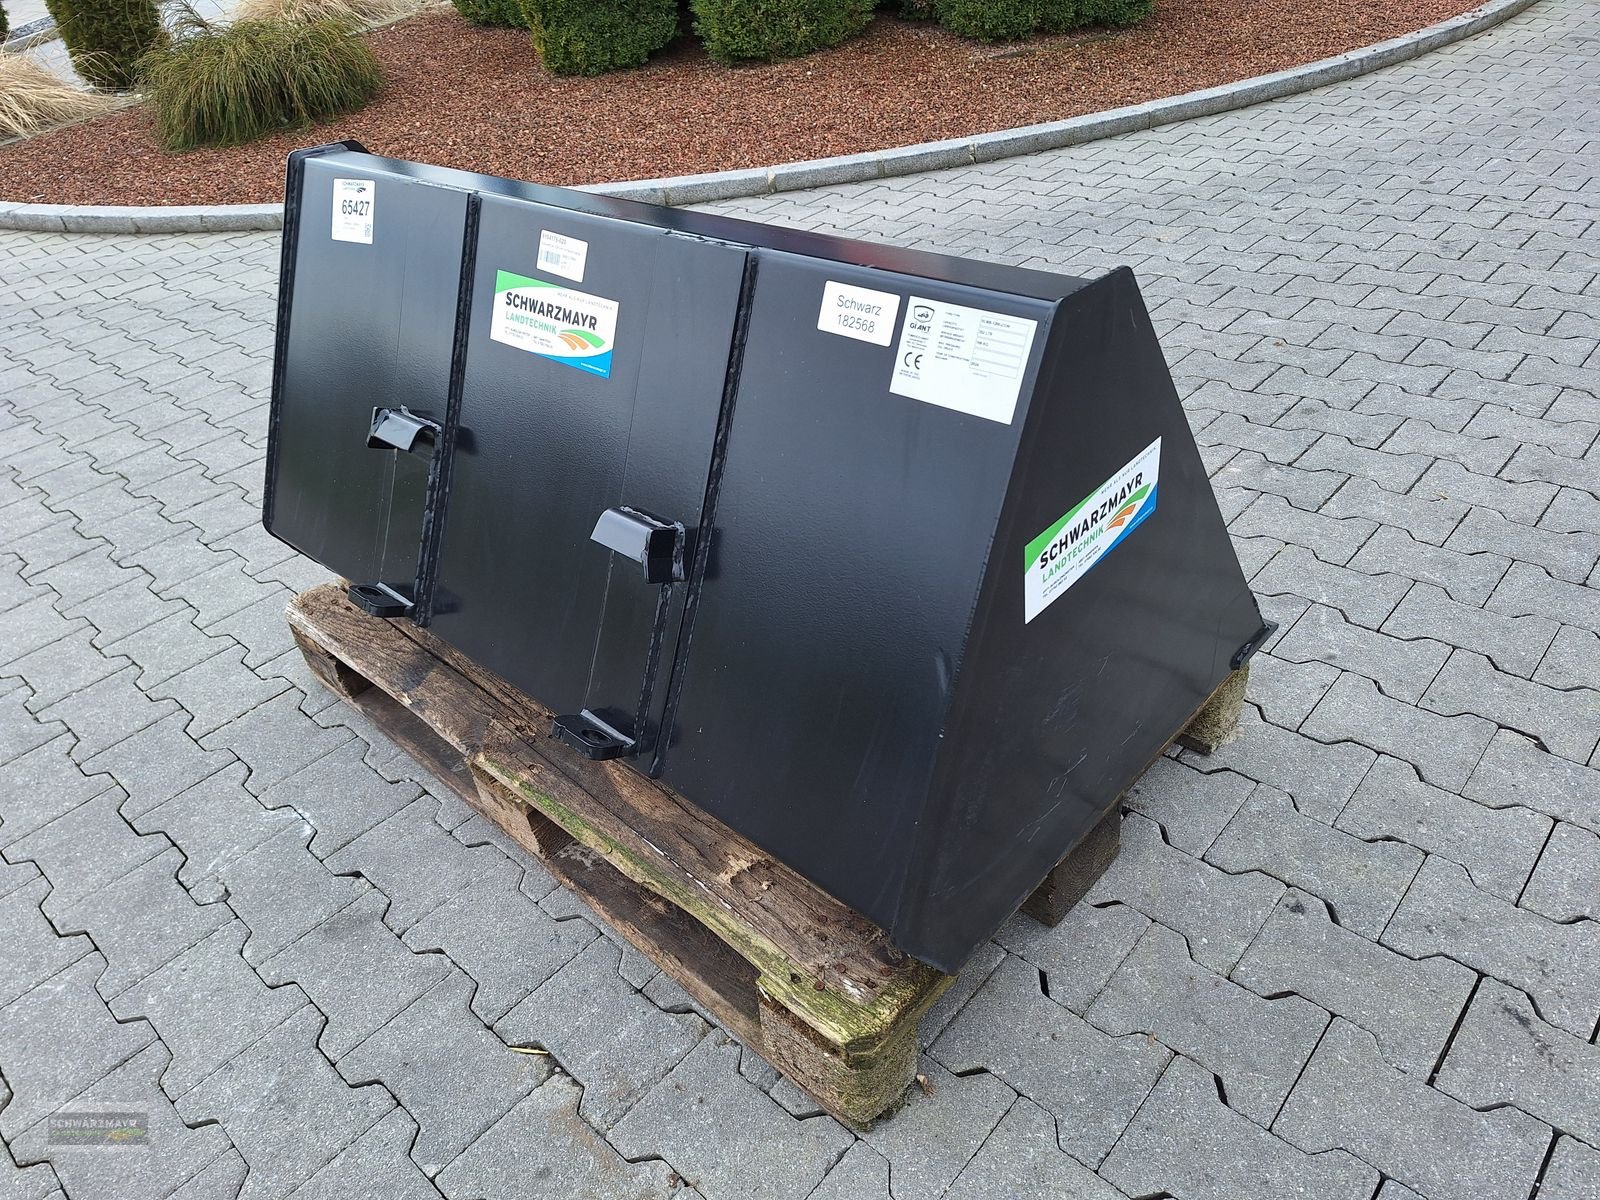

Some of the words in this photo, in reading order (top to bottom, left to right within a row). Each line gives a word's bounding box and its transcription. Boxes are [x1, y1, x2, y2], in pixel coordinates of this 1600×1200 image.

[342, 199, 370, 216] 65427
[505, 291, 598, 331] SCHWARZMAYR
[837, 294, 882, 316] Schwarz
[505, 311, 557, 335] LANDTECHNIK
[838, 314, 875, 333] 182568
[1040, 471, 1143, 569] SCHWARZMAYR
[1042, 523, 1104, 583] LANDTECHNIK
